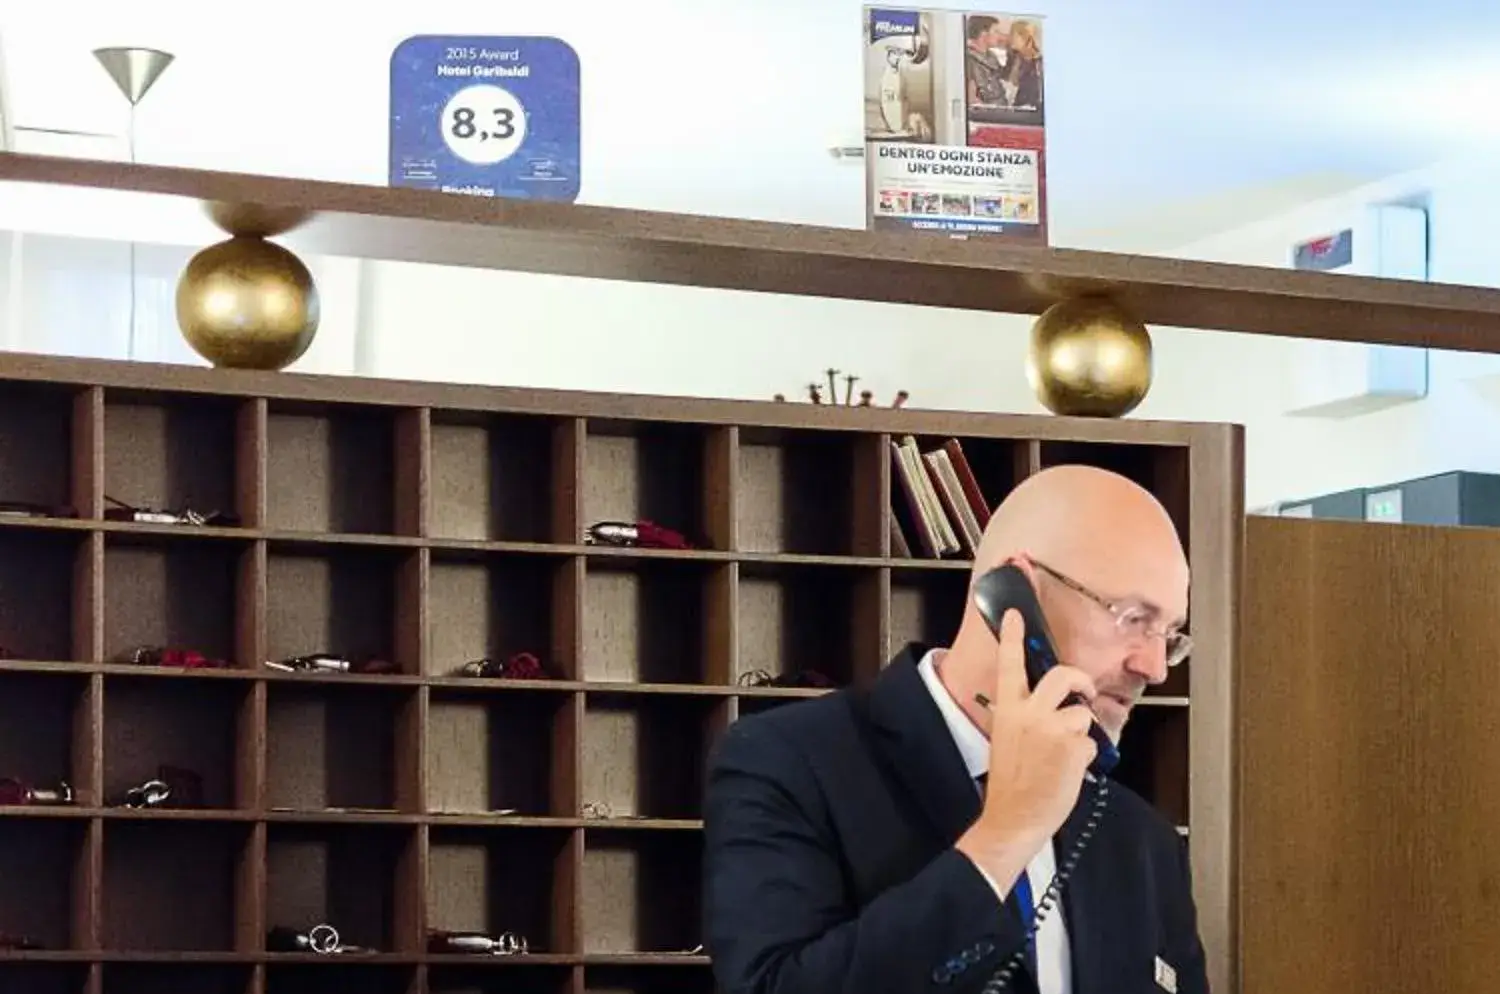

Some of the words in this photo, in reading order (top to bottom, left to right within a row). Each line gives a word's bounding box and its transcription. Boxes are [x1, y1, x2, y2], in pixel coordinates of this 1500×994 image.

[446, 47, 477, 60] 2015
[479, 48, 519, 61] Award
[437, 64, 471, 76] Hotel
[473, 65, 530, 77] Garibaldi
[451, 107, 515, 142] 8,3
[879, 146, 935, 160] DENTRO
[939, 150, 974, 163] OGNI
[977, 151, 1032, 165] STANZA
[907, 162, 1004, 178] UN'EMOZIONE
